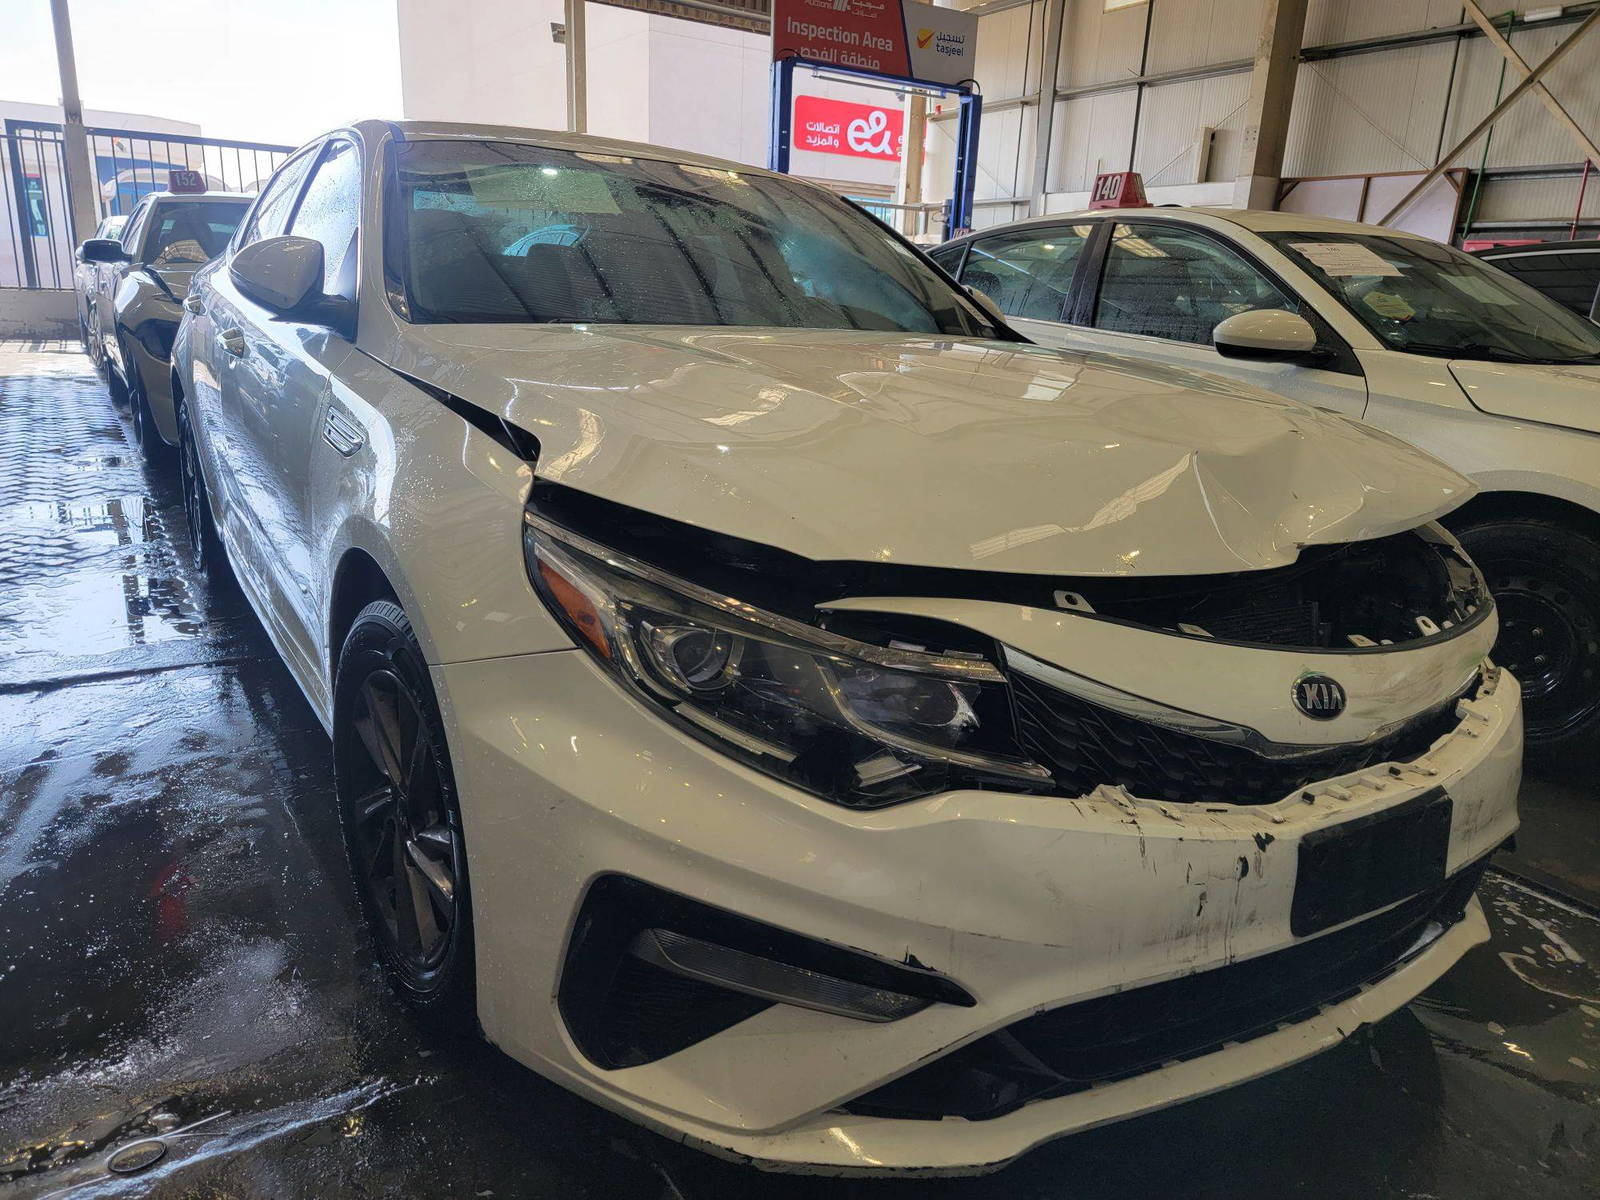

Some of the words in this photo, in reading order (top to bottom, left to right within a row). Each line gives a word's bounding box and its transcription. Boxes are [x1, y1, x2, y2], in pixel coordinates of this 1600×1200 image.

[787, 16, 859, 46] Inspection
[861, 32, 893, 52] Area
[936, 31, 966, 44] تسجيل
[794, 46, 837, 63] الفحص
[936, 42, 964, 57] tasjeel
[840, 50, 880, 72] منطقة
[806, 121, 840, 135] اتصالات
[174, 172, 197, 186] 152
[1095, 174, 1121, 201] 140
[1302, 683, 1343, 710] KIA
